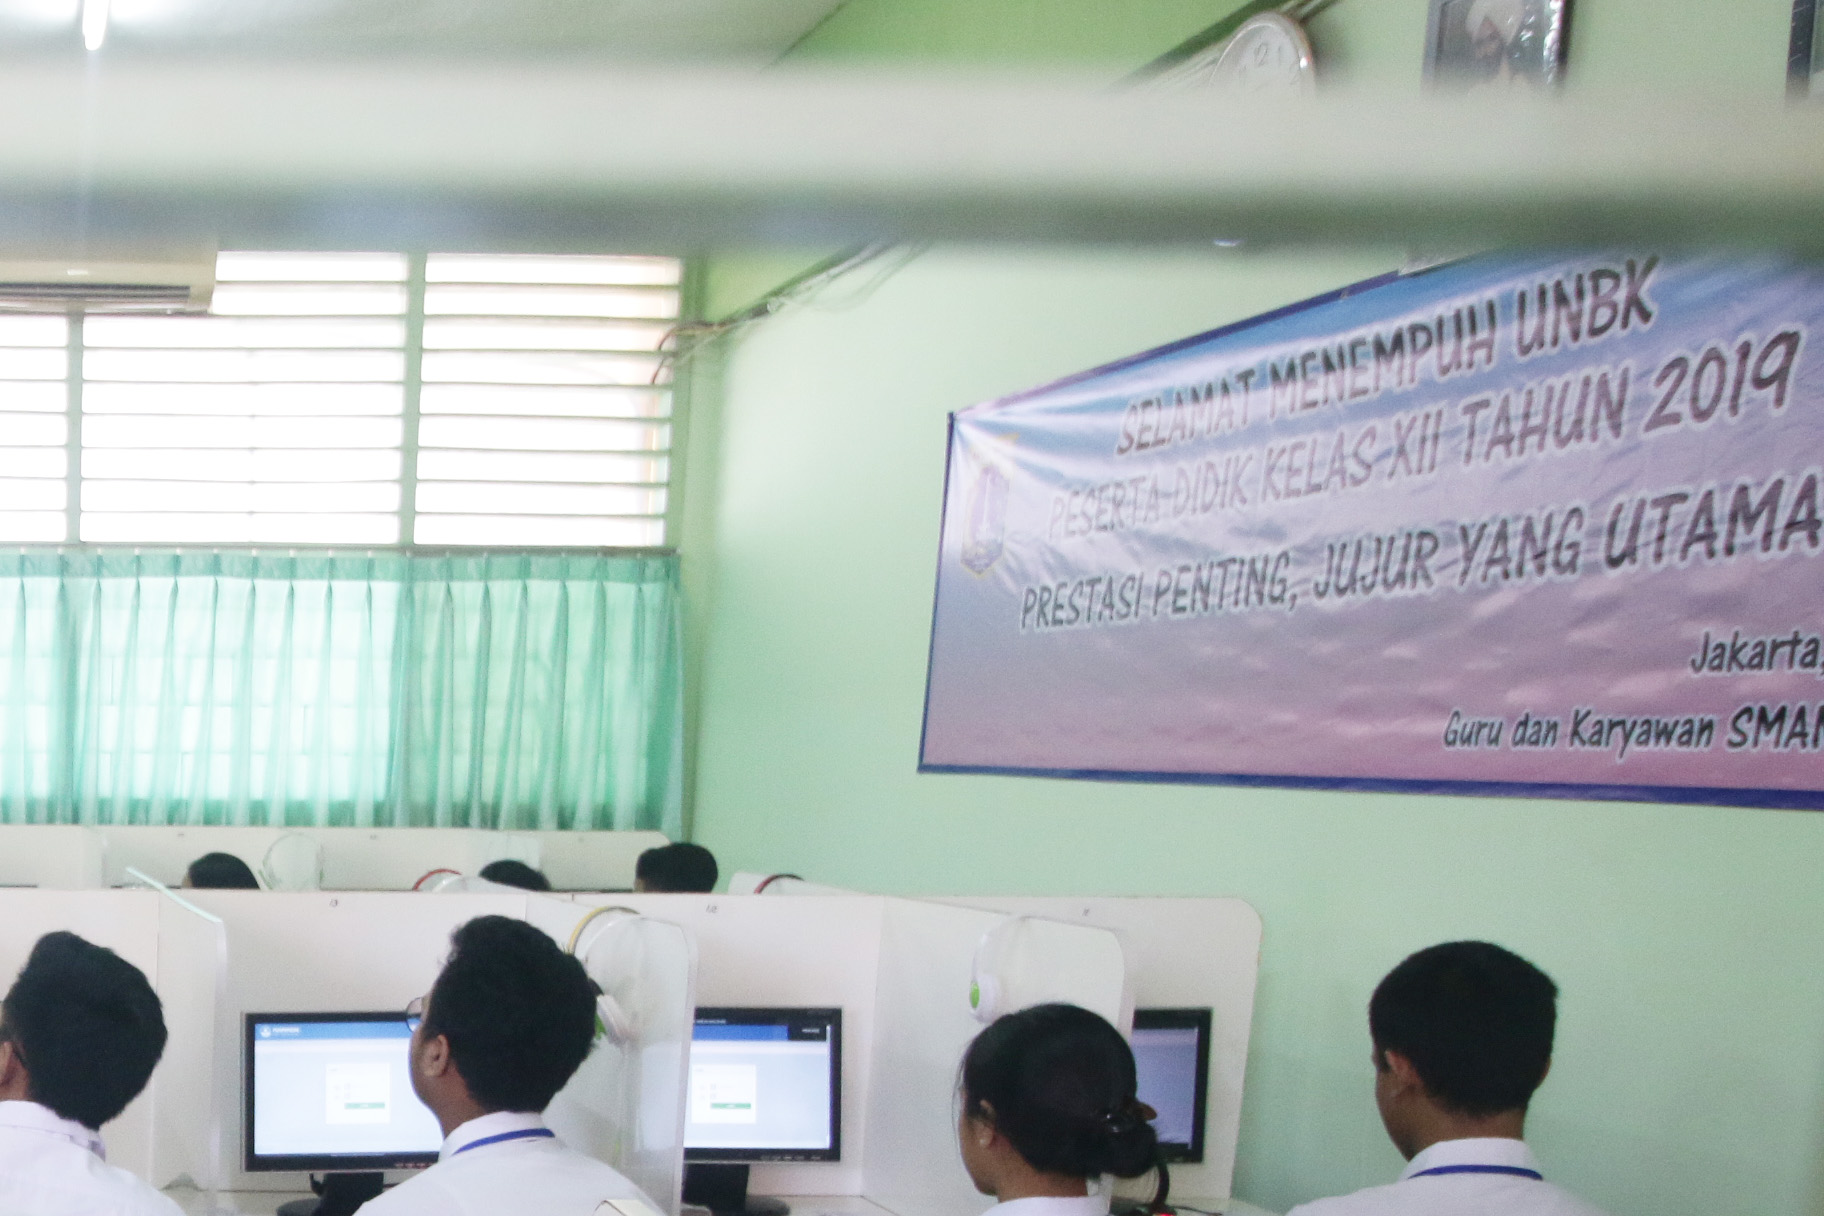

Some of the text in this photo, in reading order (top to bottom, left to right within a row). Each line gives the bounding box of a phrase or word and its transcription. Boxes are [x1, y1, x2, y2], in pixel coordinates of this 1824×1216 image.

[1049, 330, 1802, 539] PESERTA DIDIK KELAS XII TAHUN 2019
[1116, 253, 1660, 456] SELAMAT MENEMPUH UNBK
[1020, 472, 1823, 631] PRESTASI PENTING, JUJUR YANG UTAMA
[1443, 710, 1503, 748] Guru
[1511, 712, 1558, 748] dan
[1569, 708, 1715, 759] Karyawan
